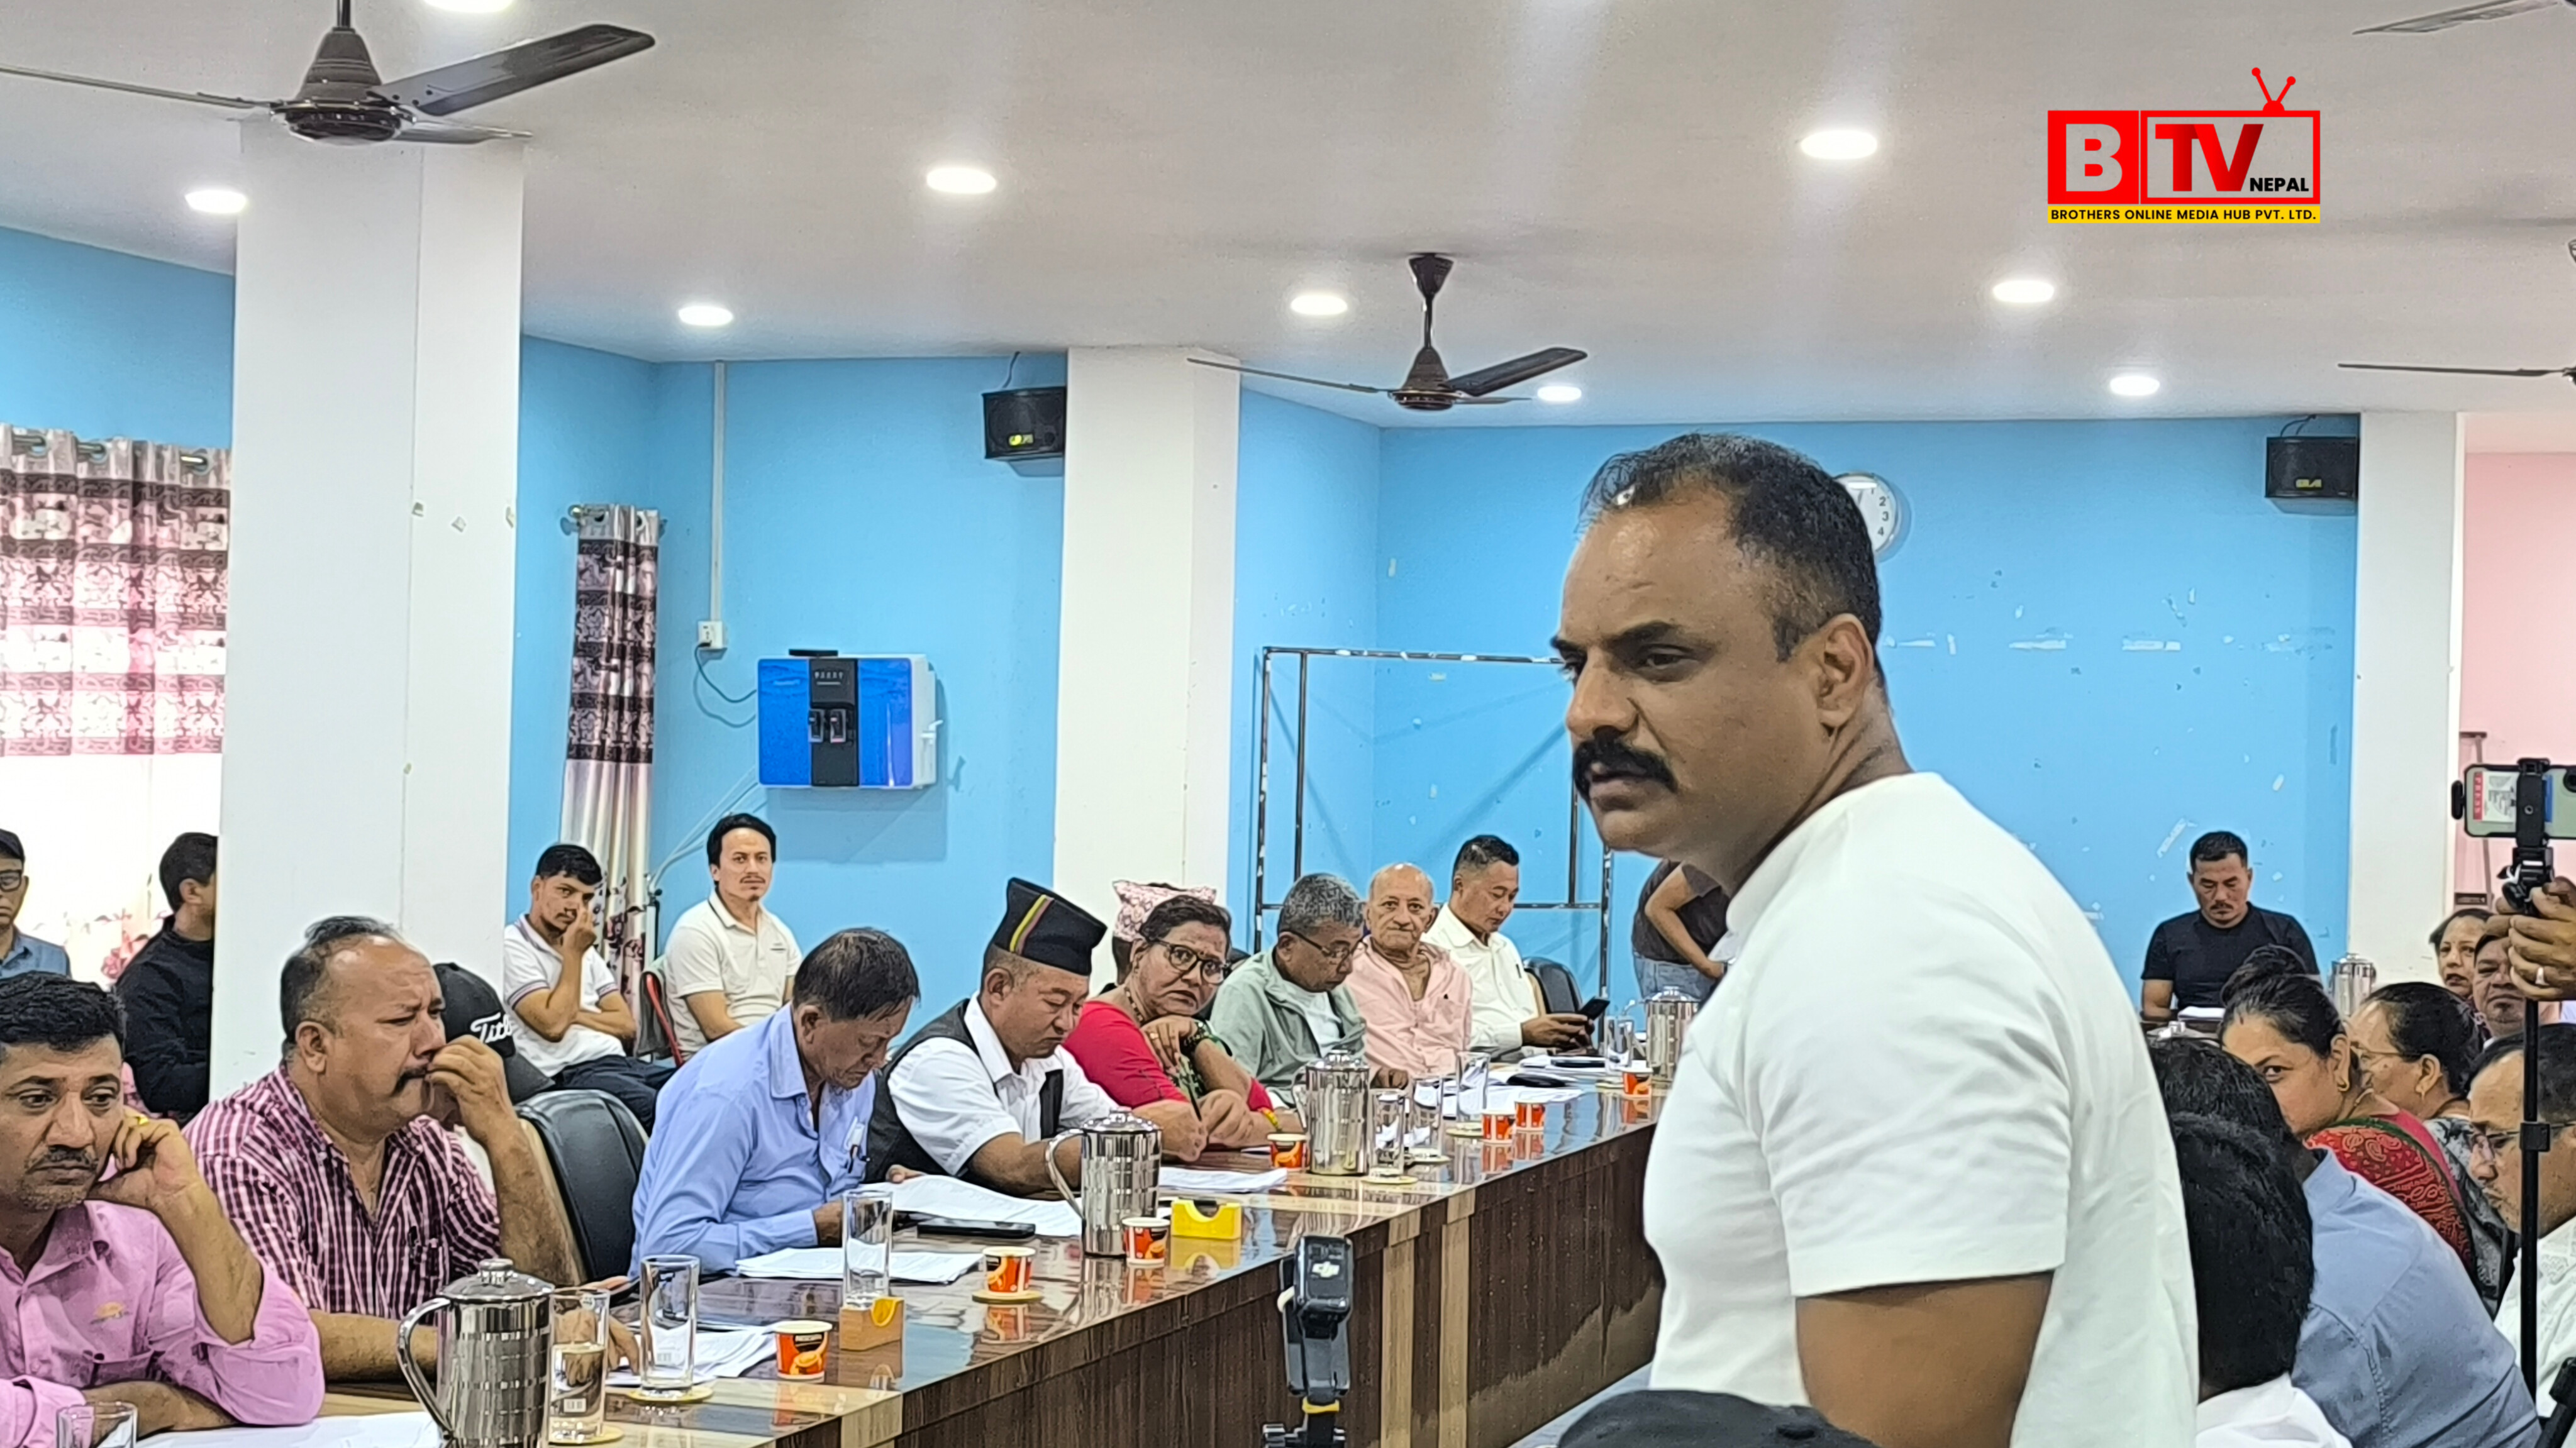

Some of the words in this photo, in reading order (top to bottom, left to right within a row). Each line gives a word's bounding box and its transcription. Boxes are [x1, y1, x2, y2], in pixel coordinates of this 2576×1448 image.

[1879, 495, 1886, 506] 2
[1882, 511, 1889, 521] 3
[1877, 526, 1884, 536] 4
